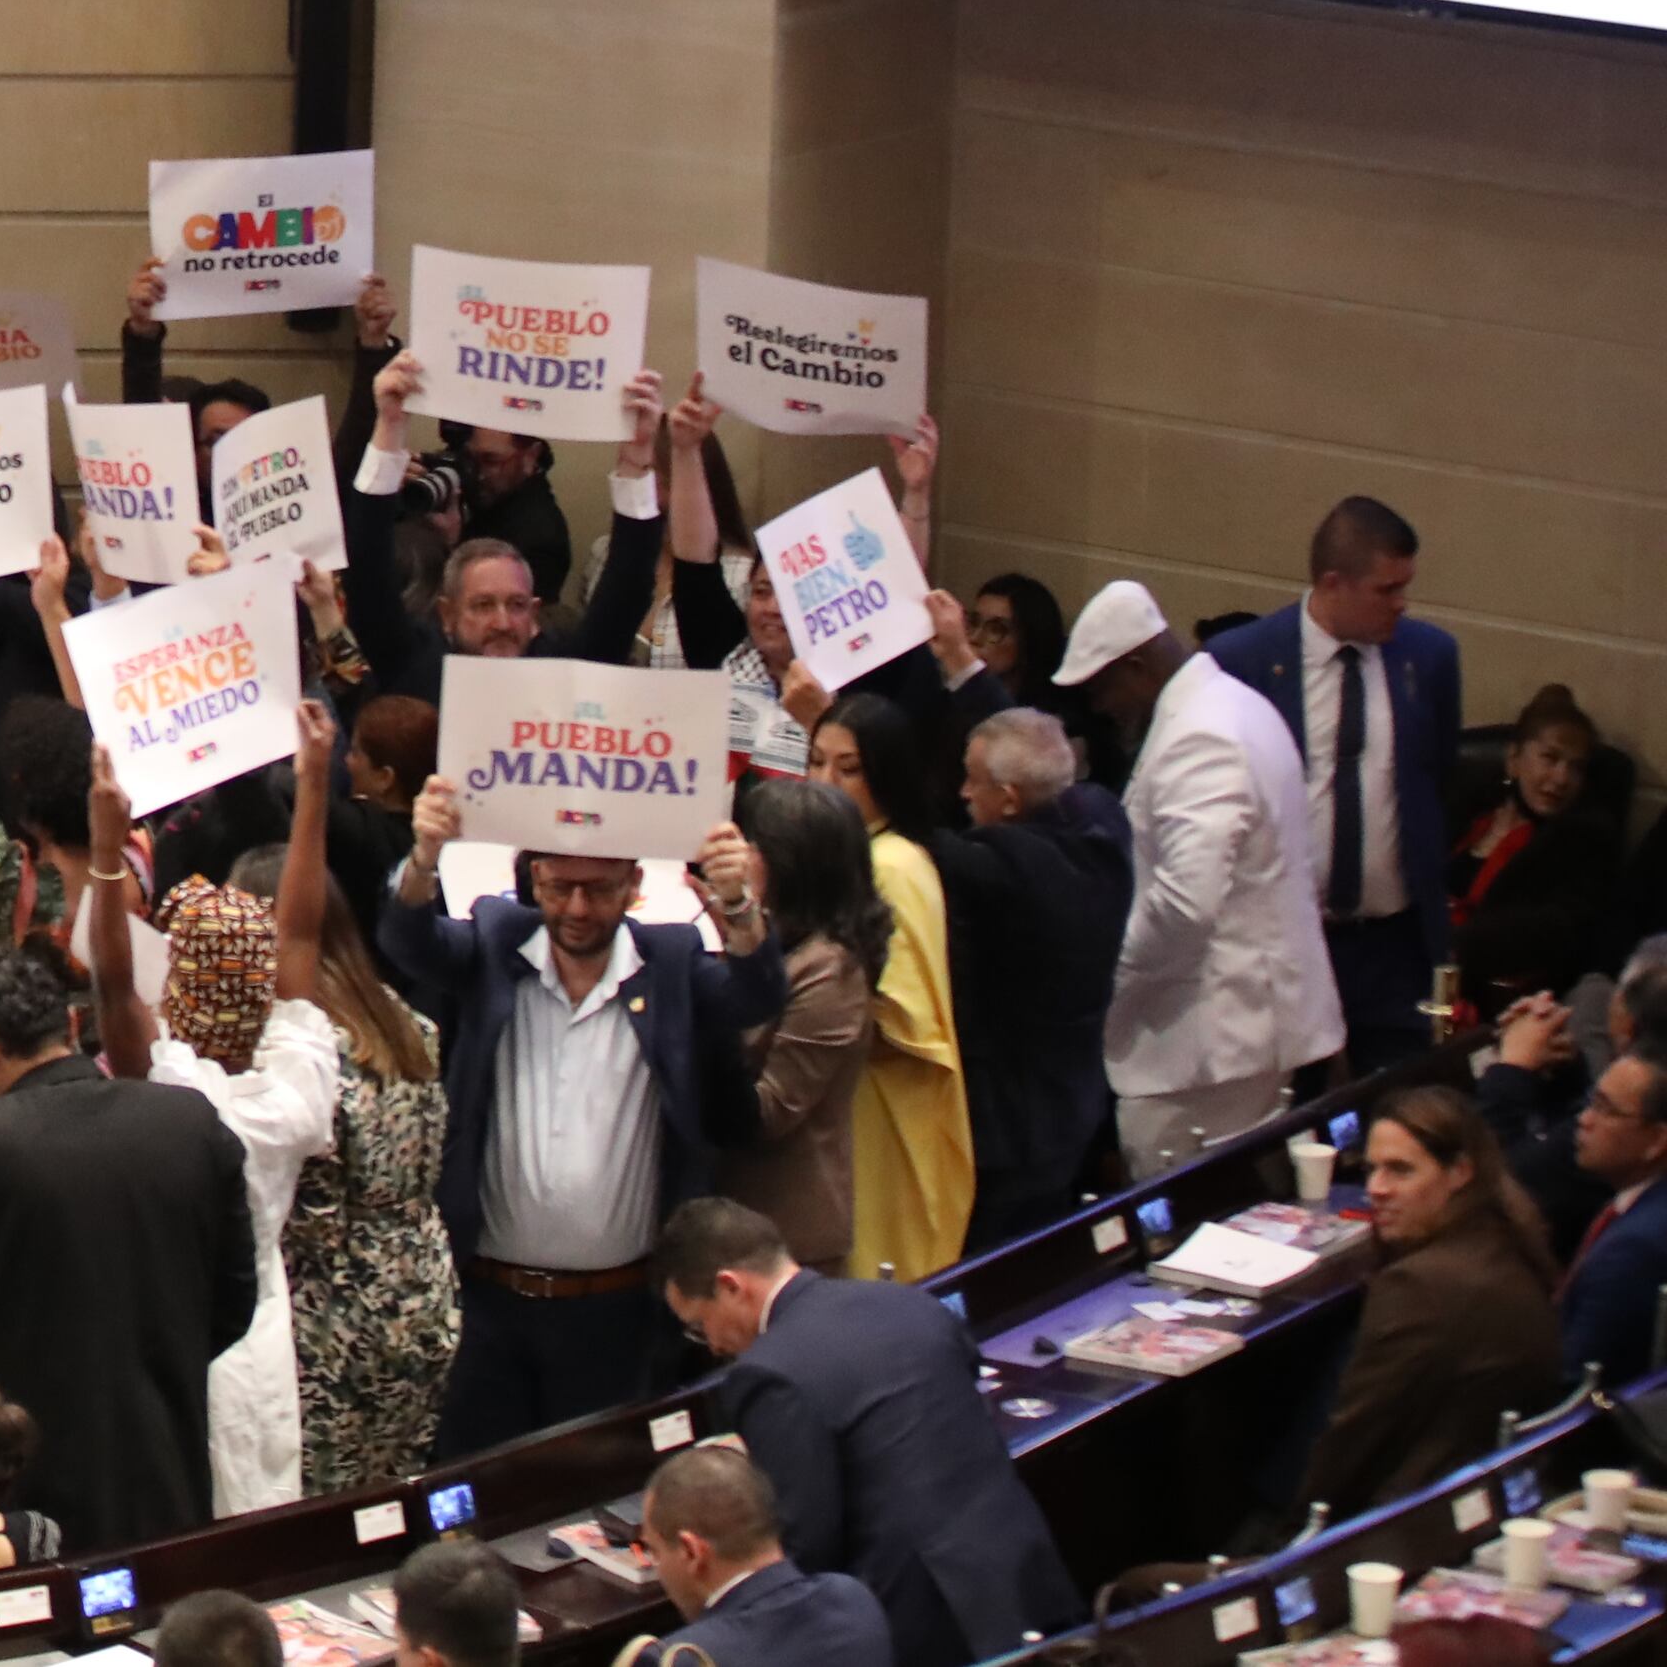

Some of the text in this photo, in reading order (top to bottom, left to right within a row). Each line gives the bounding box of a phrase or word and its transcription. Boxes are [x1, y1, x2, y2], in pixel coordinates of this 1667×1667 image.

[182, 205, 347, 252] CAMBIO
[183, 244, 341, 273] no retrocede
[459, 300, 611, 337] PUEBLO
[724, 314, 900, 364] Reelegiremos
[486, 330, 571, 357] NO SE
[728, 341, 885, 389] el Cambio
[457, 345, 606, 392] RINDE!
[804, 579, 888, 646] PETRO
[112, 621, 246, 683] ESPERANZA
[113, 640, 257, 716] VENCE
[130, 719, 161, 753] AL
[166, 679, 261, 744] MIEDO
[511, 721, 673, 758] PUEBLO
[467, 750, 699, 796] MANDA!
